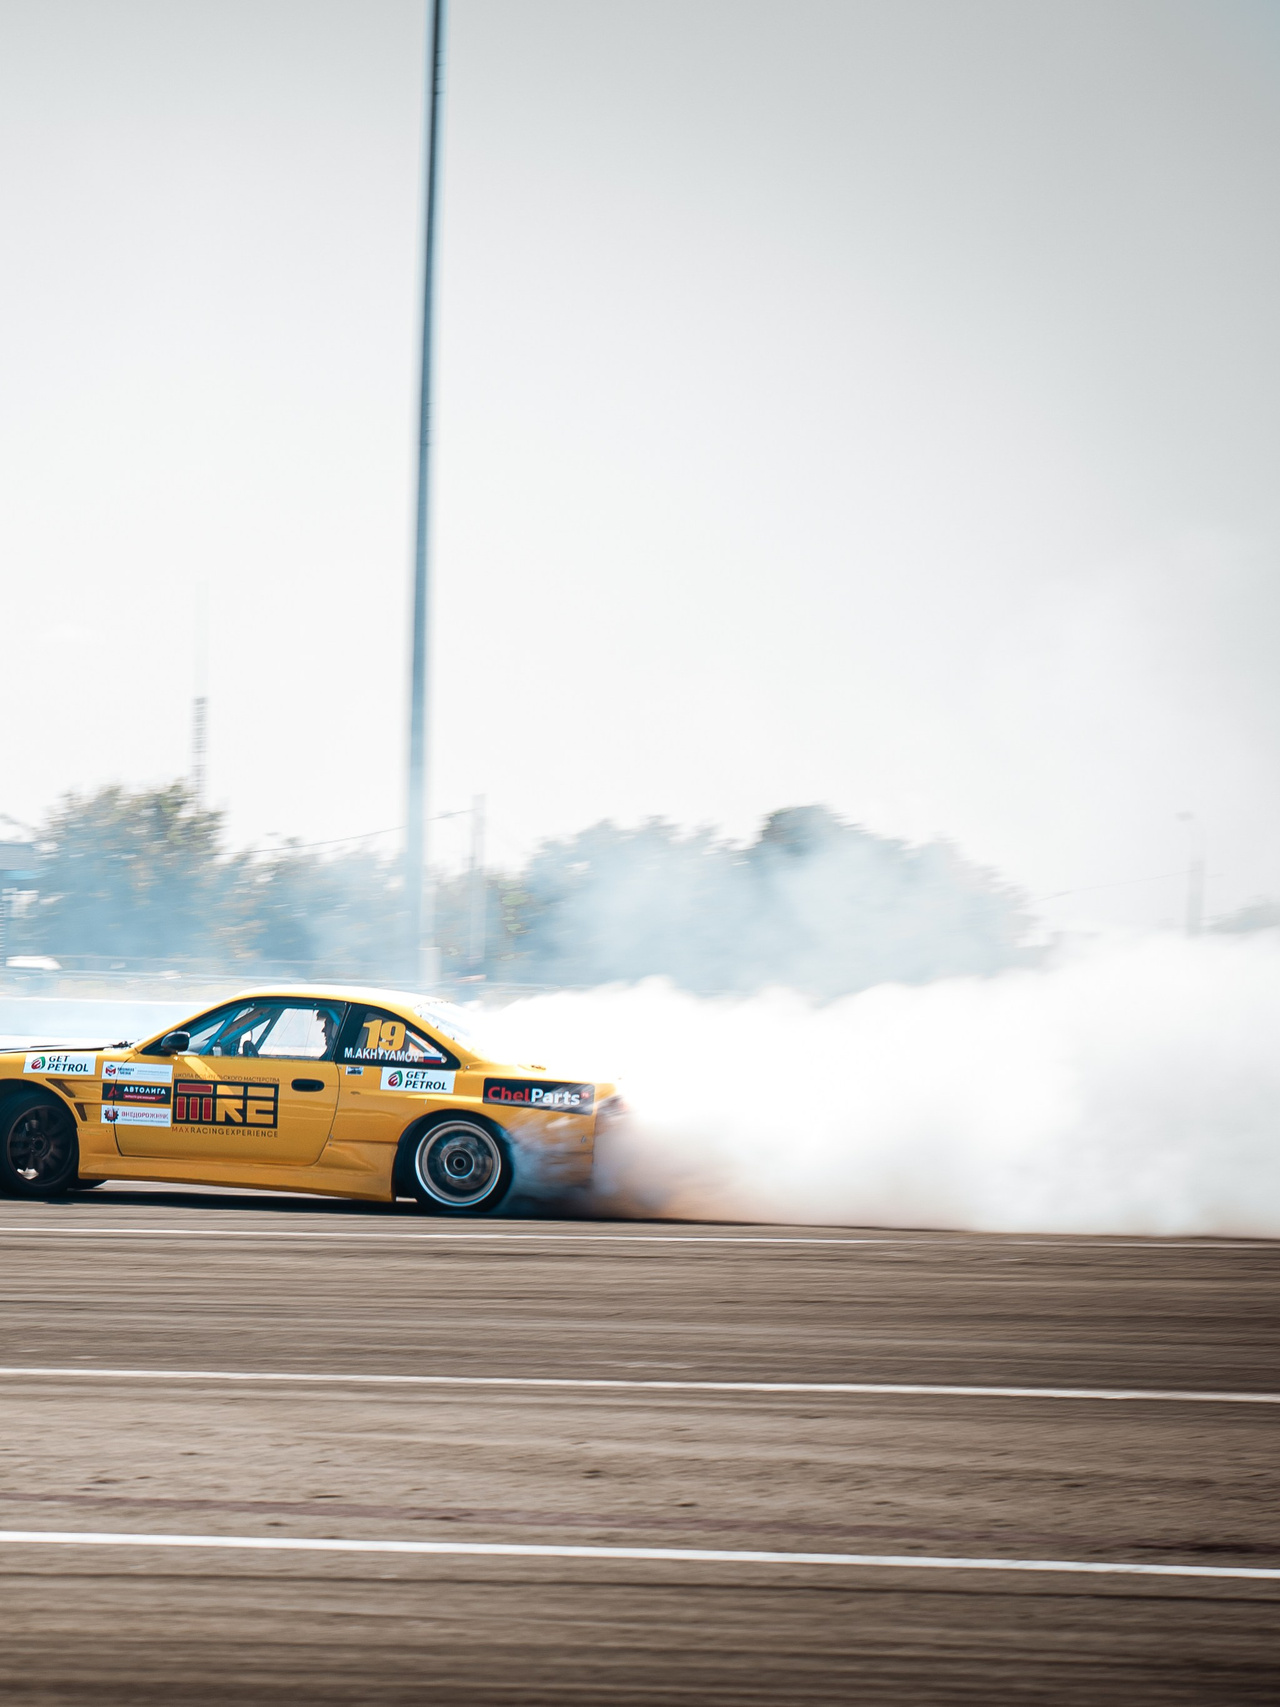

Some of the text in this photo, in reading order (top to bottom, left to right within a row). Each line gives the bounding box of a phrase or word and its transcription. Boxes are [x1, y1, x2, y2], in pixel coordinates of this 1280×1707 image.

[363, 1019, 406, 1051] 19
[48, 1055, 70, 1063] GET
[47, 1063, 88, 1072] PETROL
[405, 1071, 428, 1079] GET
[404, 1080, 447, 1090] PETROL
[123, 1086, 166, 1095] АВТОЛИГА
[487, 1086, 581, 1106] ChelParts
